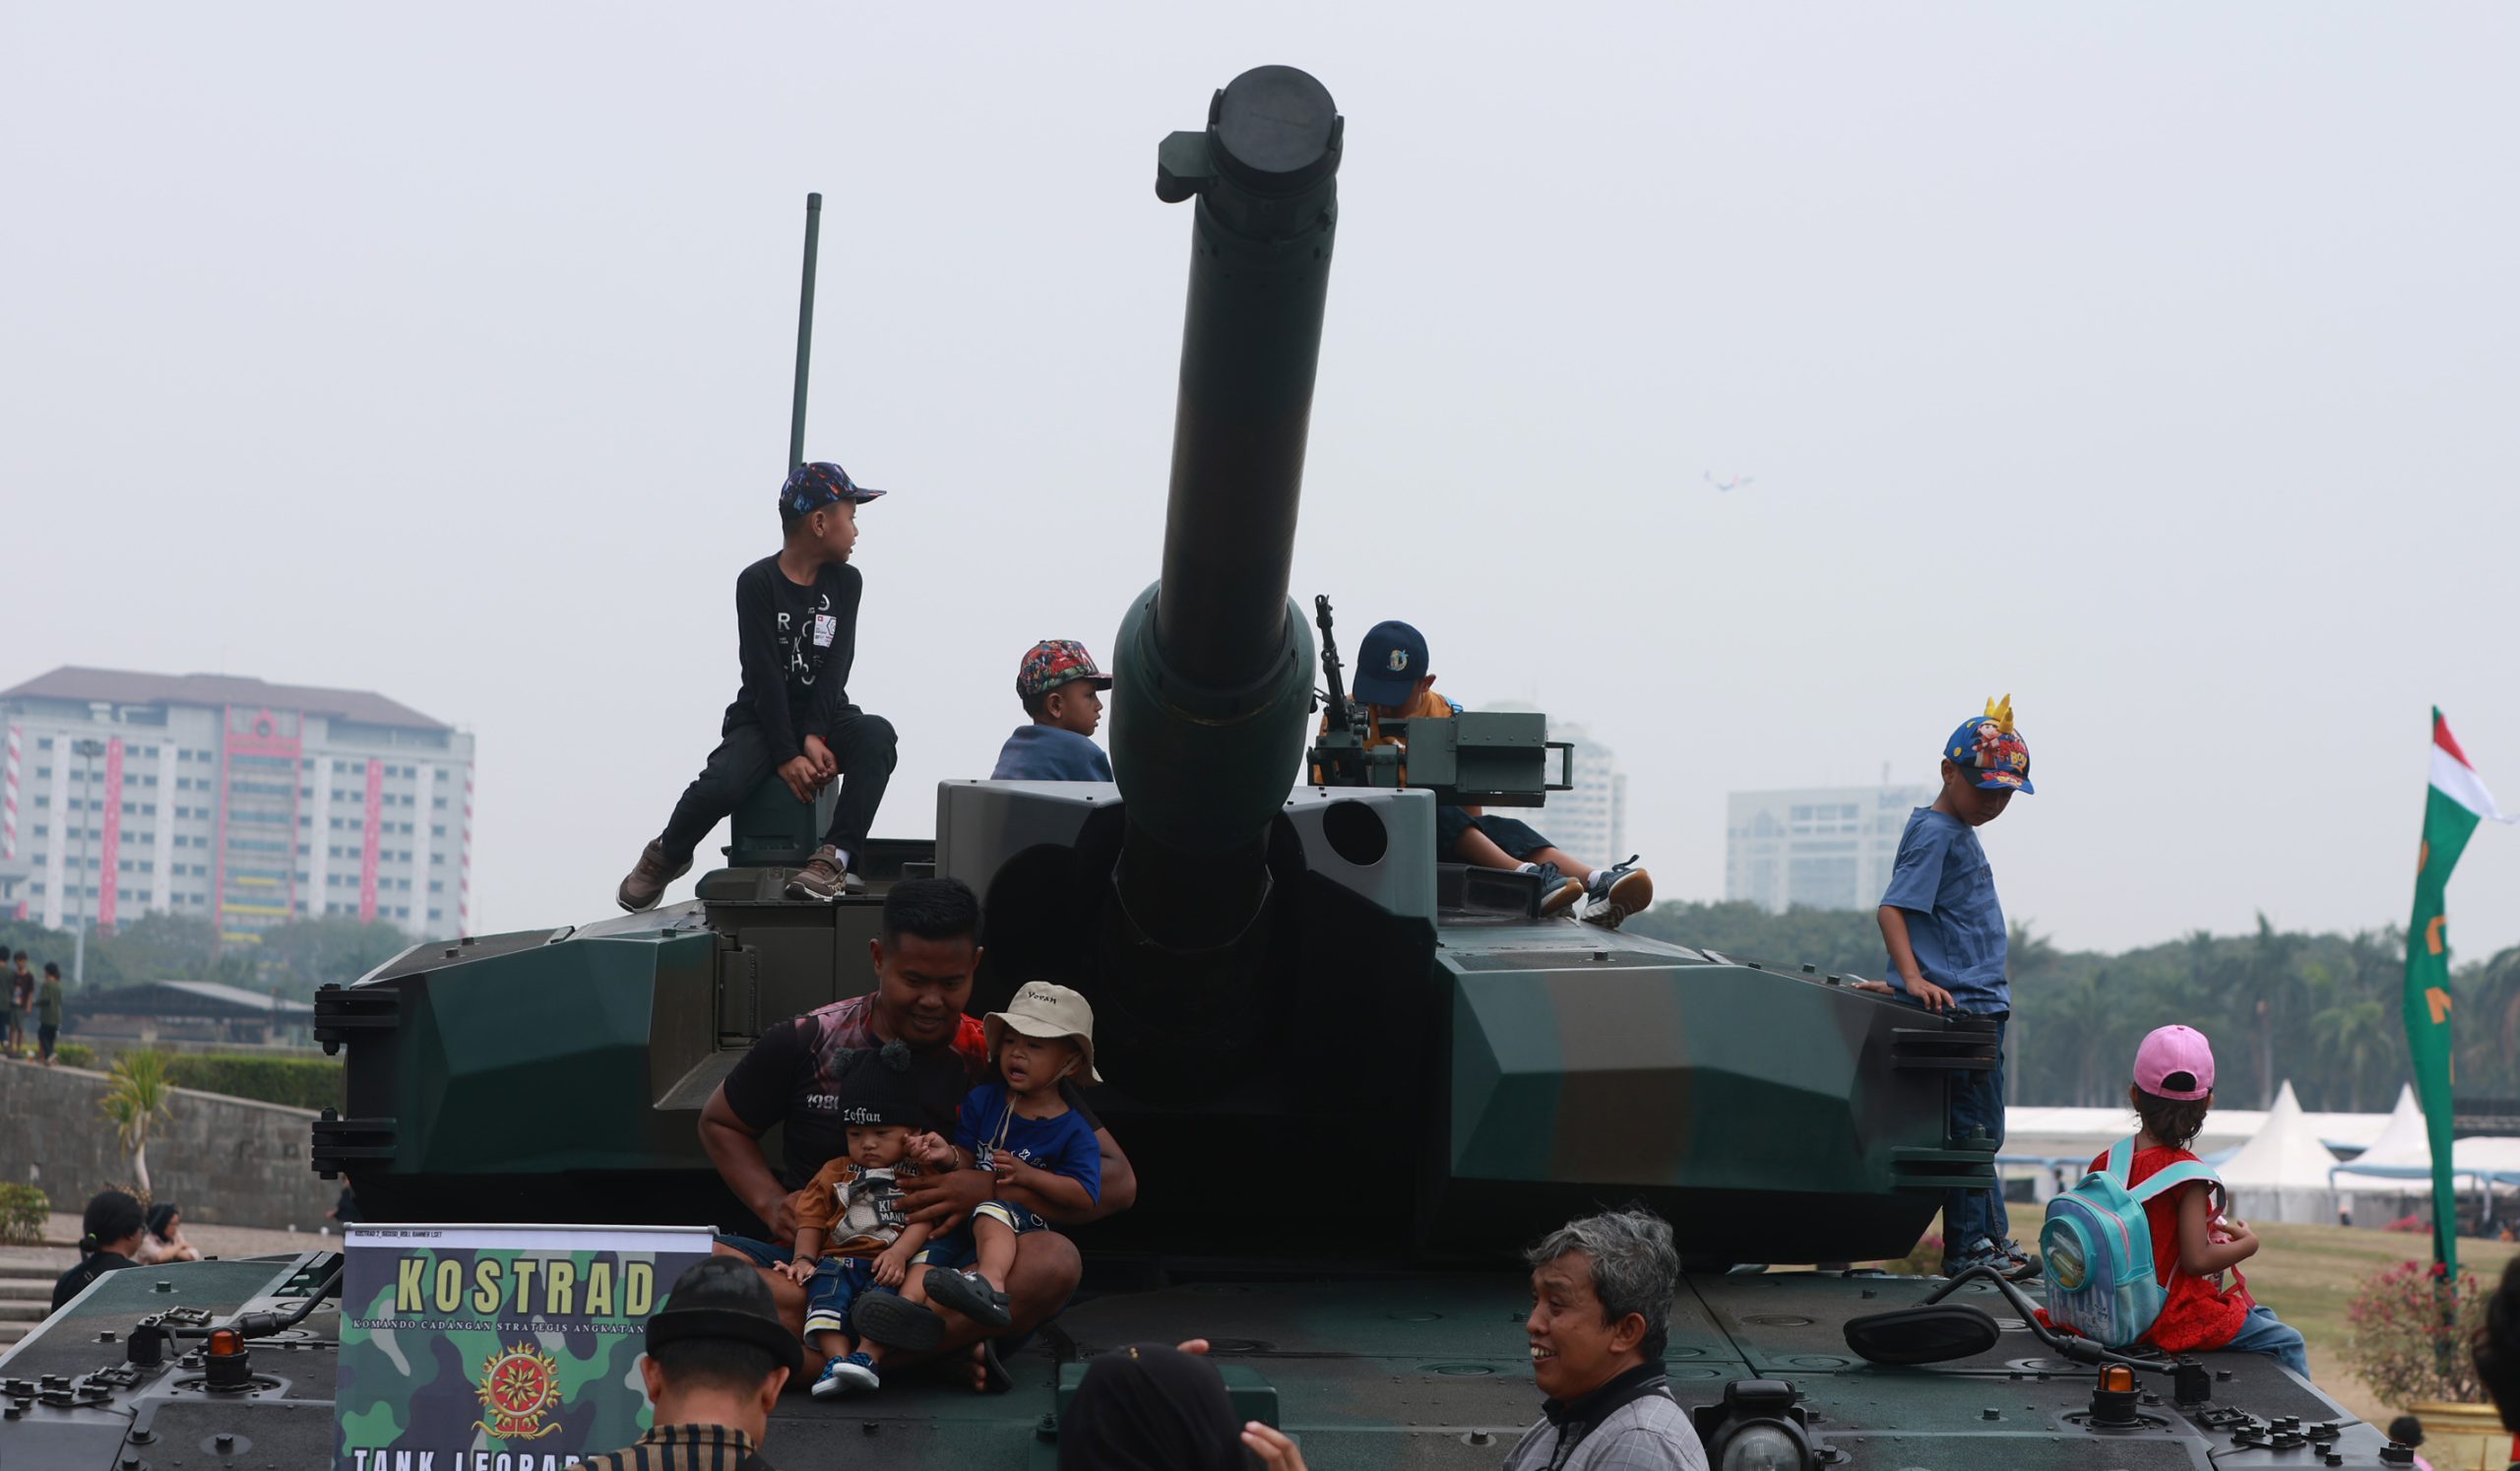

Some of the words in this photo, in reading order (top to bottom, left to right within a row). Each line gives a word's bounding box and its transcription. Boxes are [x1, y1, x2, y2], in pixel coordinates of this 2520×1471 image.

[778, 612, 790, 631] R
[396, 1258, 655, 1316] KOSTRAD
[353, 1319, 416, 1329] KOMANDO
[420, 1320, 492, 1330] CADANGAN
[496, 1321, 568, 1332] STRATEGIS
[573, 1323, 646, 1334] ANGKATAN
[353, 1448, 435, 1471] TANK
